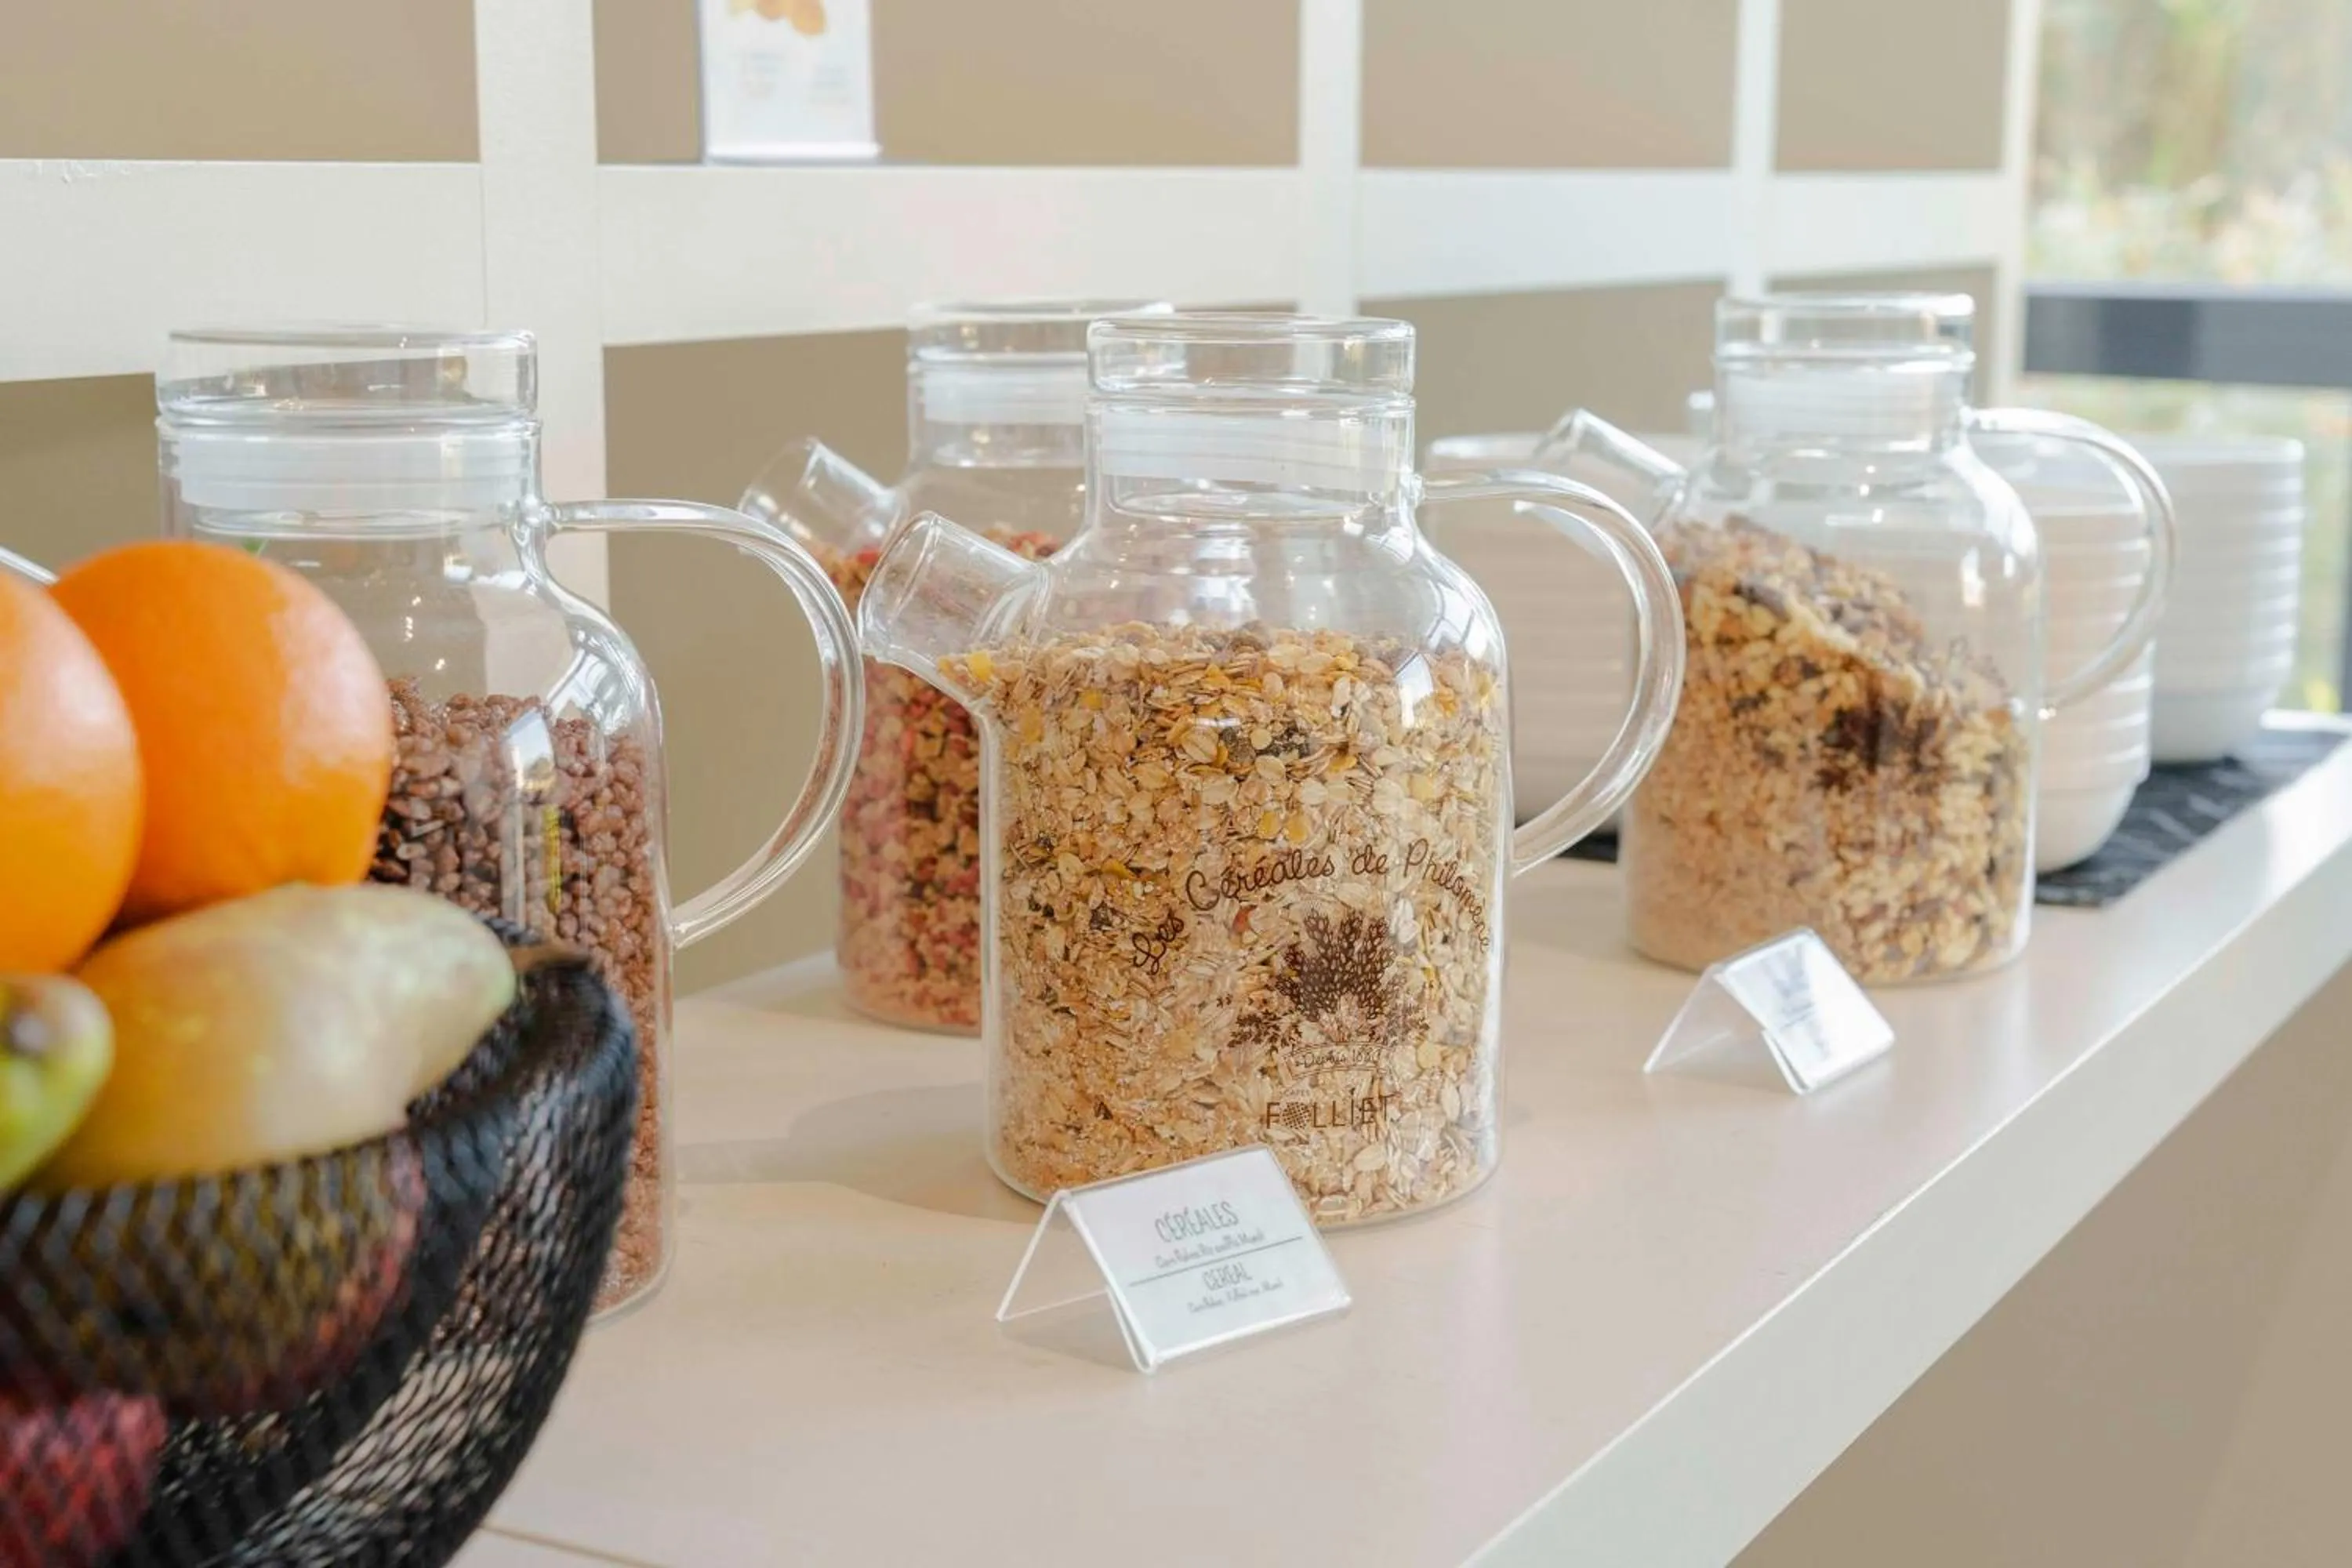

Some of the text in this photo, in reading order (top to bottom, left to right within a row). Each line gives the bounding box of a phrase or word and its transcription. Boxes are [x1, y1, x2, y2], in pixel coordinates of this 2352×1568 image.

[1132, 908, 1185, 975] Les
[1185, 848, 1335, 911] Céréales
[1352, 844, 1388, 875] de
[1266, 1092, 1402, 1129] FOLLIET
[1155, 1201, 1239, 1243] CÉRÉALES
